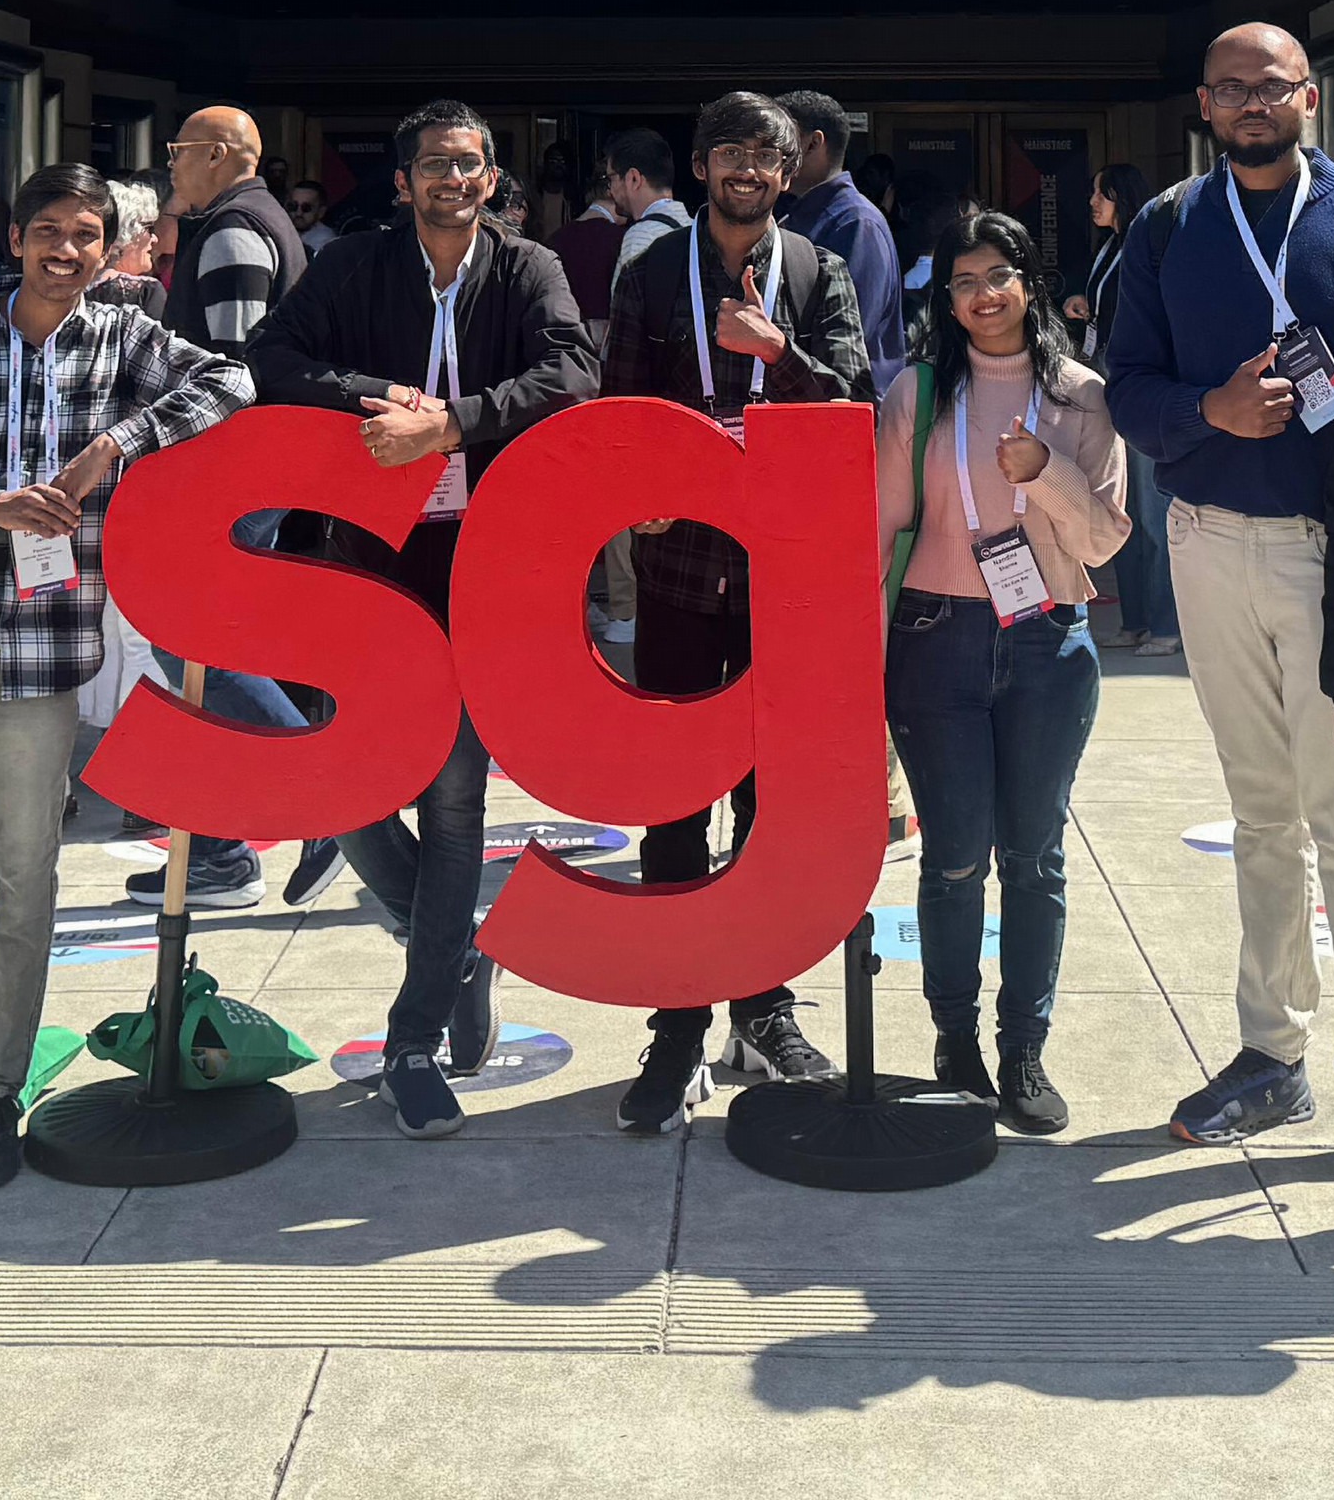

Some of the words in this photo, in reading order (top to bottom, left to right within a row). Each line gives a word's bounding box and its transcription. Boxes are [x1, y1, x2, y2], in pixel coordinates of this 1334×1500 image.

[908, 140, 956, 150] MAINSTAGE
[1024, 140, 1072, 150] MAINSTAGE
[1041, 174, 1058, 266] CONFERENCE
[80, 396, 889, 1008] sg
